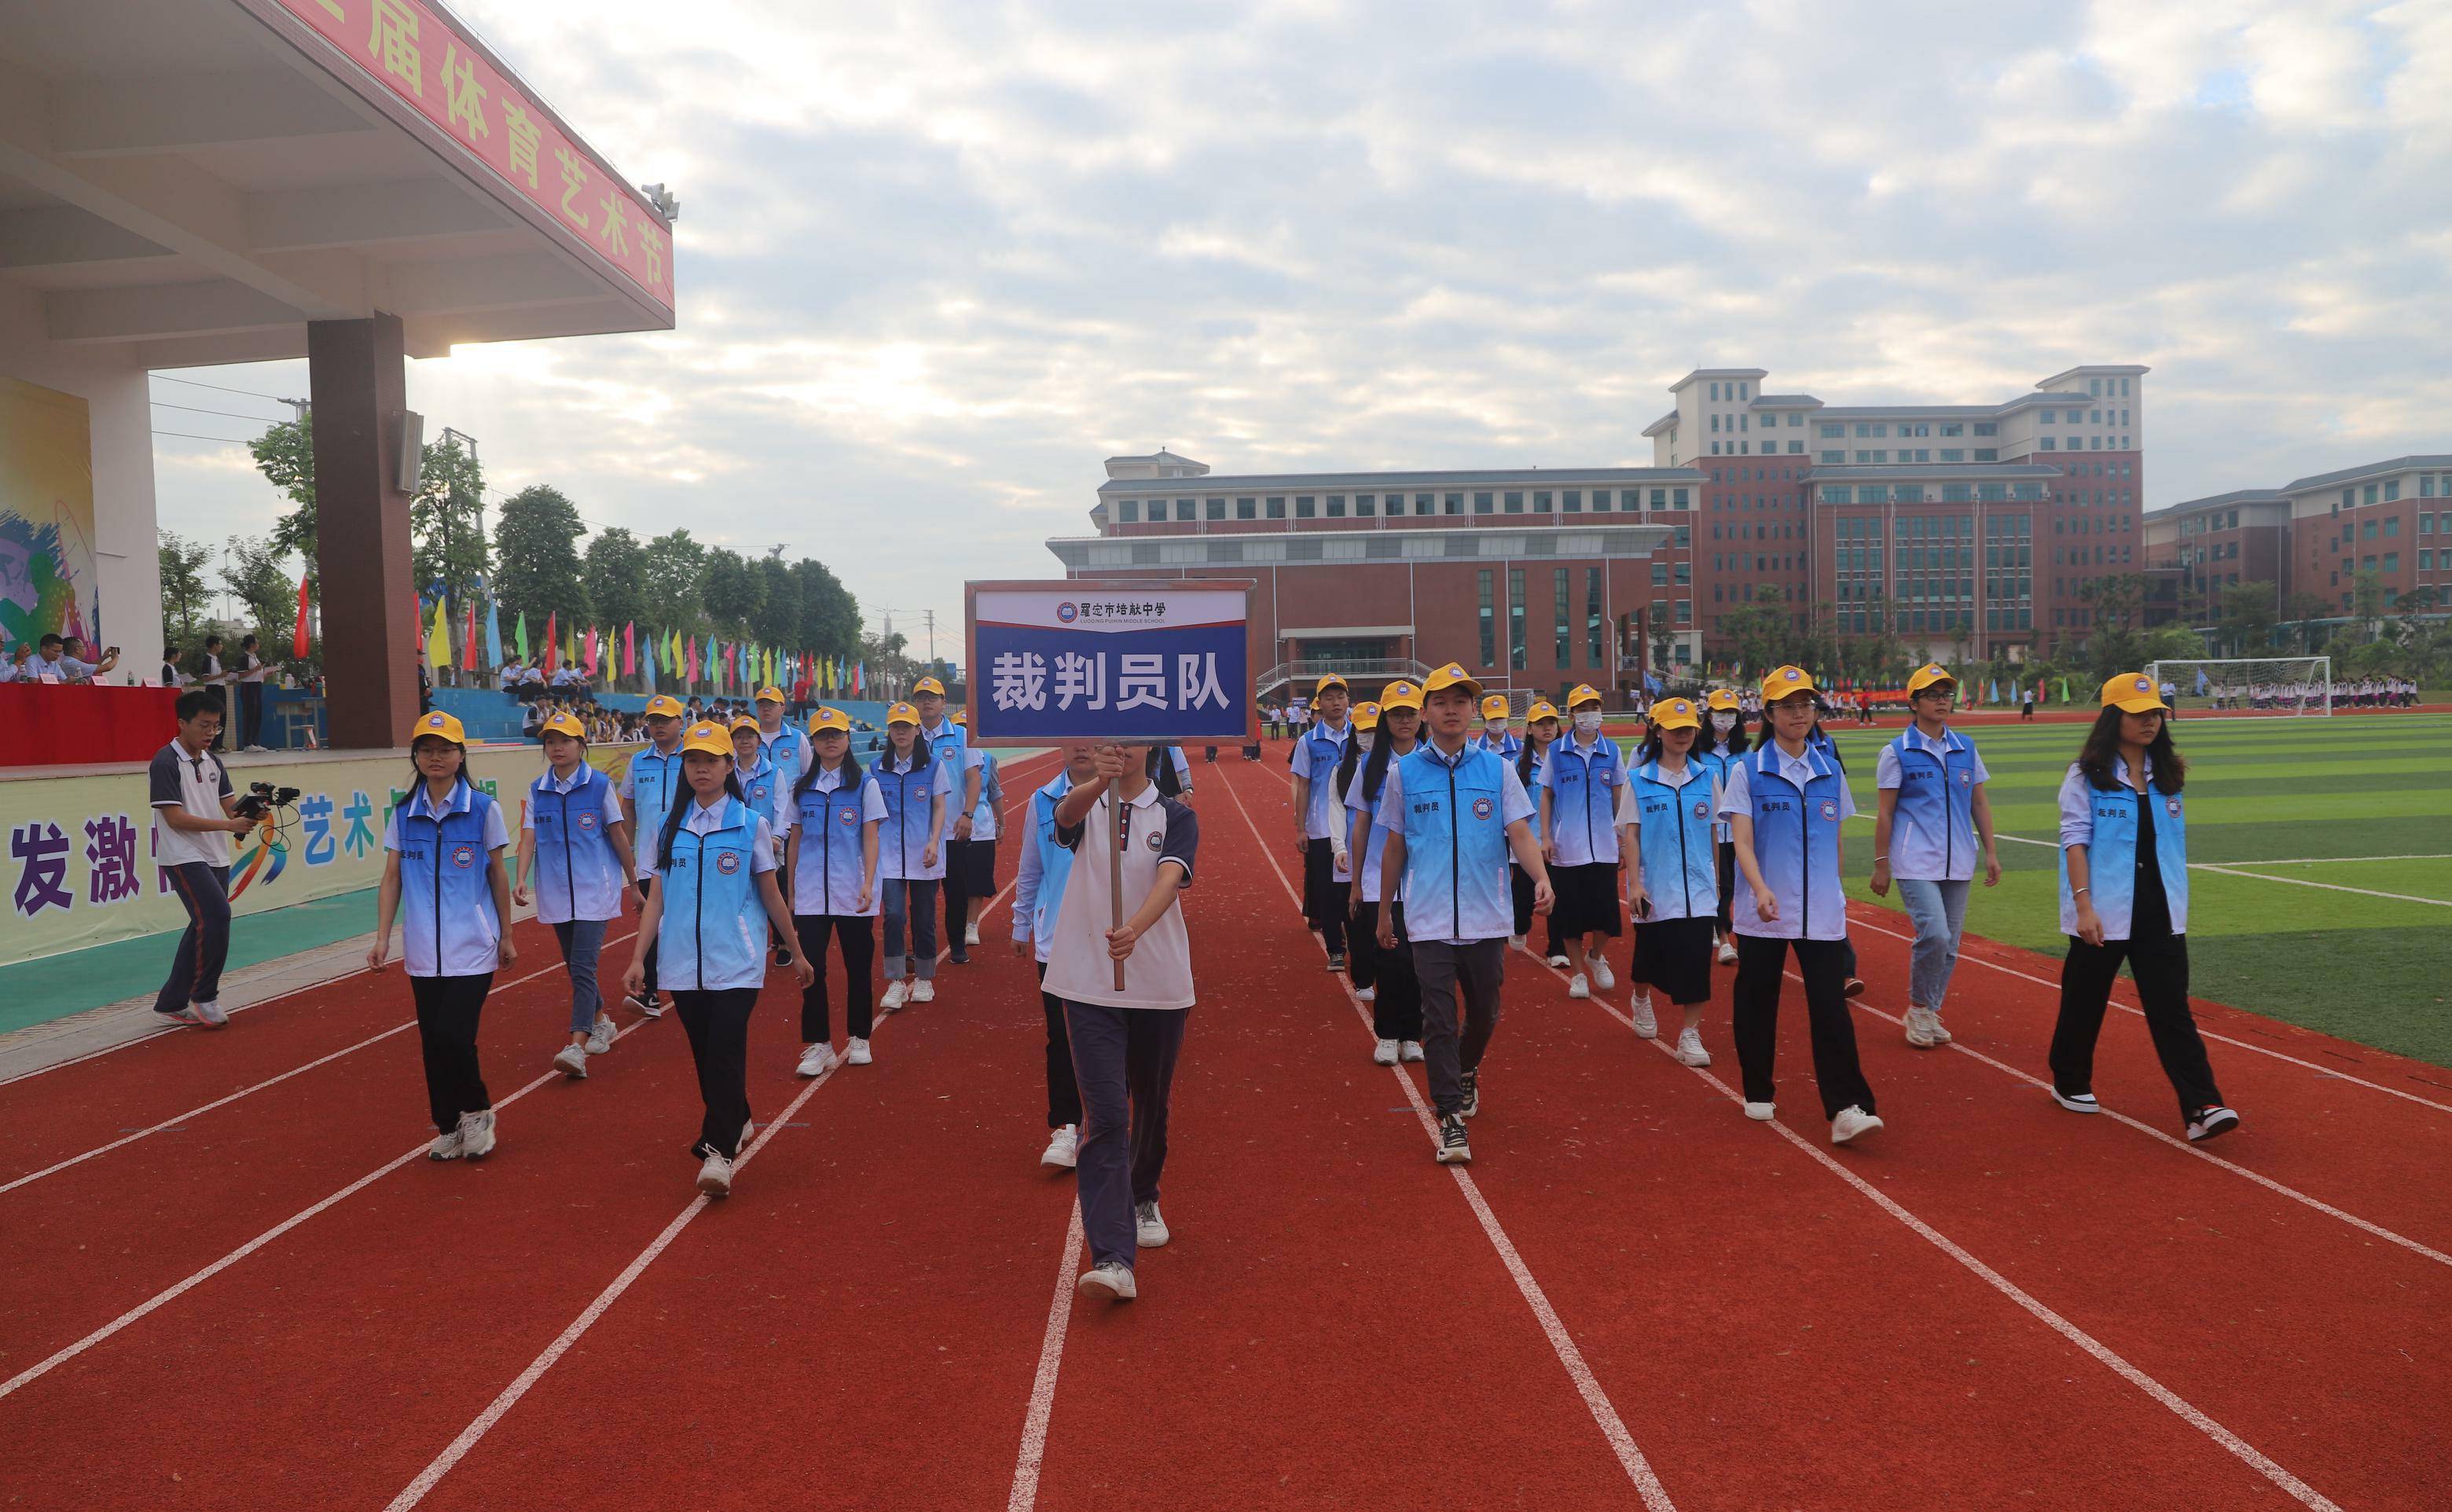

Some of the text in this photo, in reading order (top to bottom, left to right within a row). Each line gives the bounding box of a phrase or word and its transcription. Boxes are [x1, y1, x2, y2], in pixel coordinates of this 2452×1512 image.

[992, 651, 1231, 711] 裁判员队
[1414, 802, 1440, 813] 裁判员
[1646, 802, 1668, 813] 裁判员
[1761, 802, 1790, 813] 裁判员
[2098, 808, 2127, 819] 裁判员
